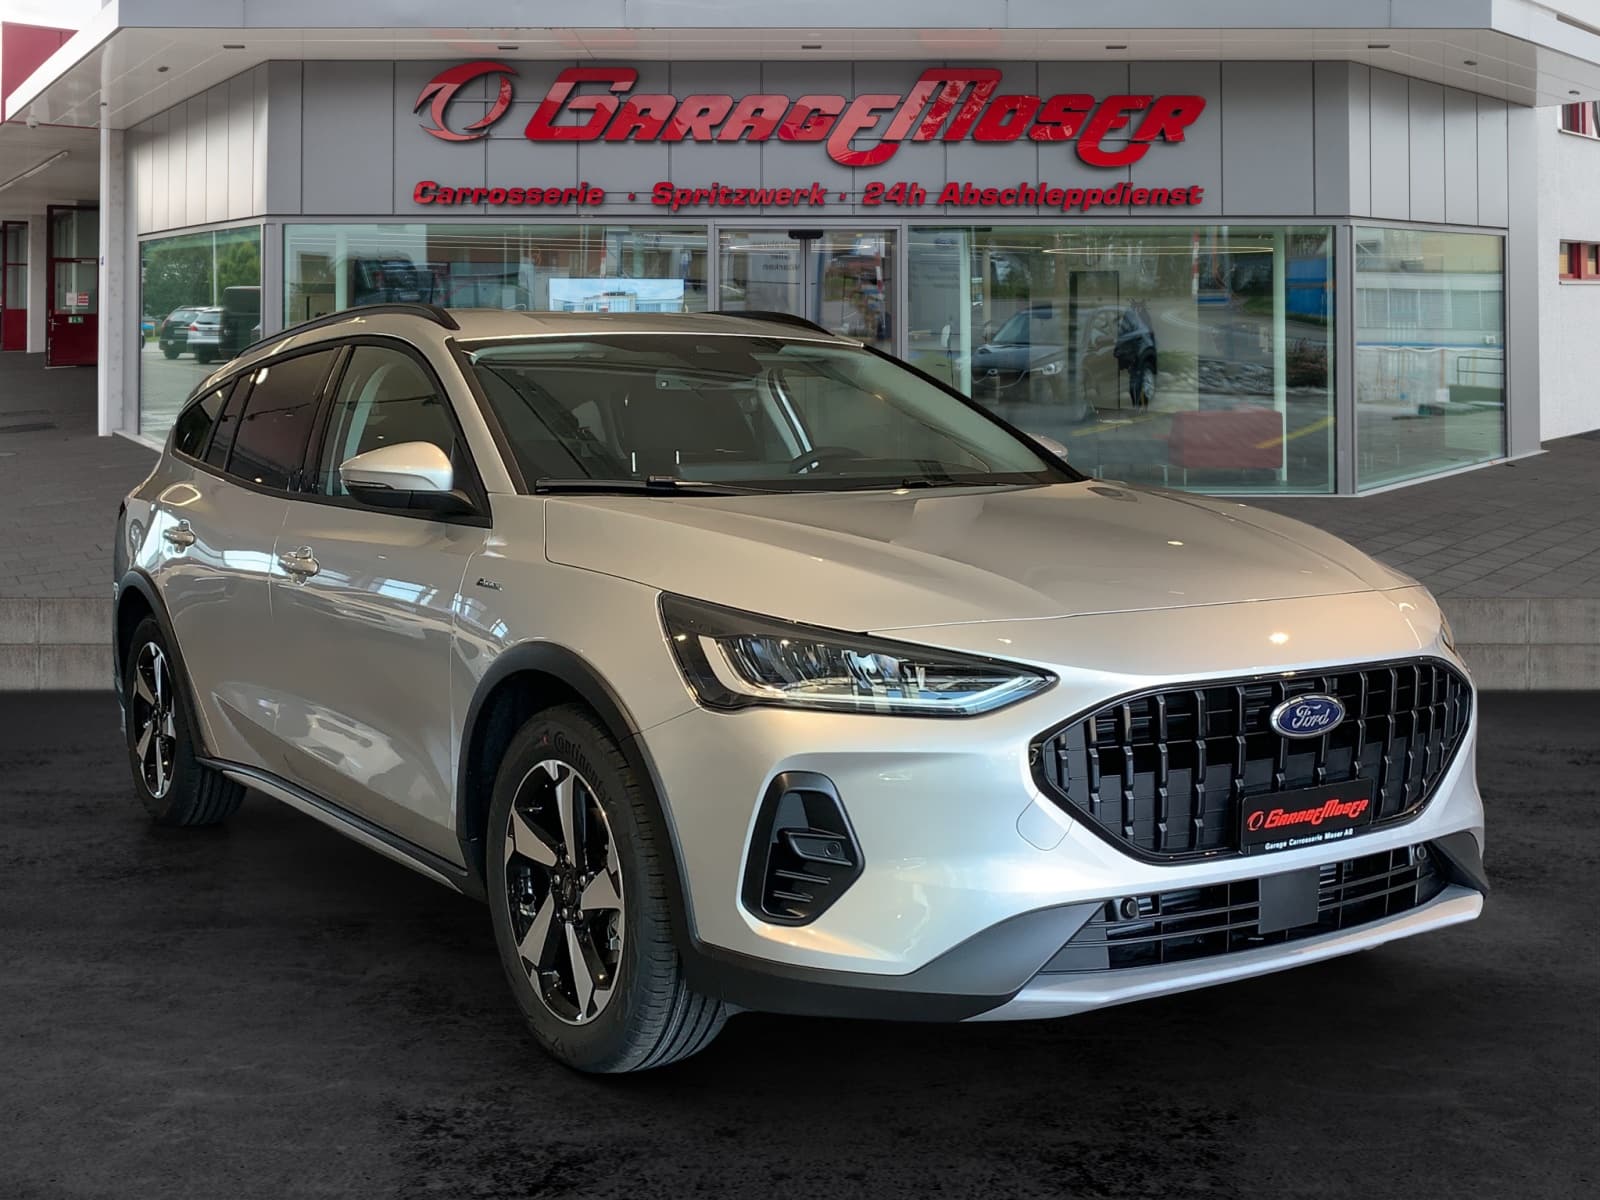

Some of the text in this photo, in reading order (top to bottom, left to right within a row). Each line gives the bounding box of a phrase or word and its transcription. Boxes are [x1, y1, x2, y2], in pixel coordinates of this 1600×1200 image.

[413, 181, 1205, 213] Carrosserie Spritzwerk 24h Abschleppdienst
[1291, 704, 1330, 729] Ford
[1264, 840, 1288, 850] Garage
